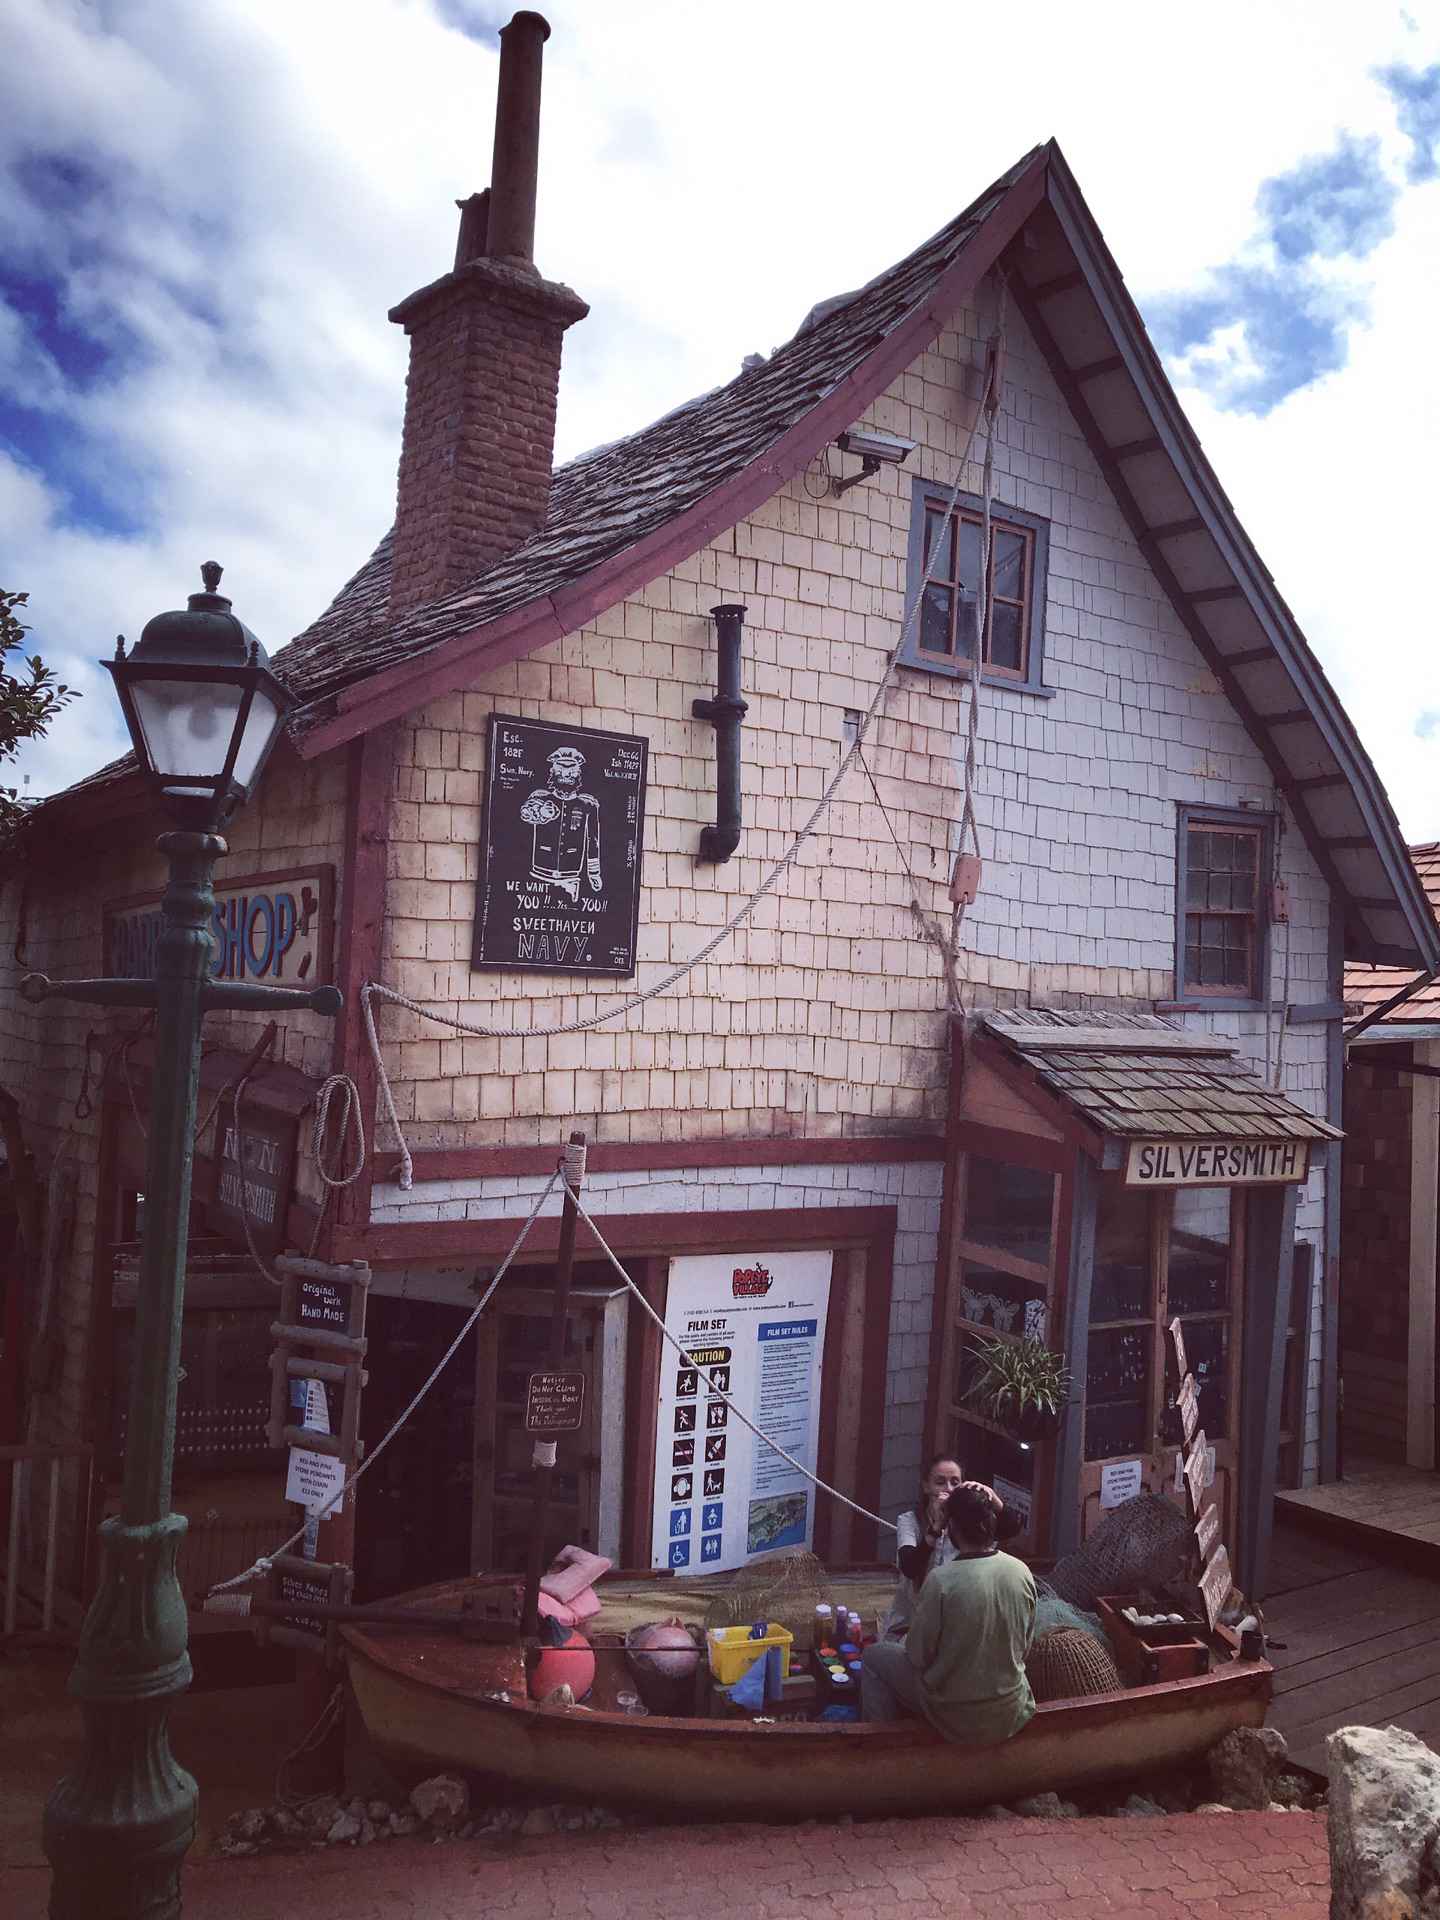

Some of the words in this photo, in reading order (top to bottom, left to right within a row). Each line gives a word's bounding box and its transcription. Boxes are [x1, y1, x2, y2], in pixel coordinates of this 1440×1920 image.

[506, 881, 521, 891] WE
[526, 881, 551, 893] WANT
[516, 894, 540, 910] YOU
[512, 917, 595, 935] SWEETHAVEN
[208, 893, 297, 978] SHOP
[1138, 1144, 1297, 1179] SILVERSMITH
[323, 1307, 345, 1322] MADE
[688, 1320, 709, 1332] FILM
[711, 1319, 727, 1330] SET
[767, 1328, 780, 1336] FILM
[781, 1327, 791, 1335] SET
